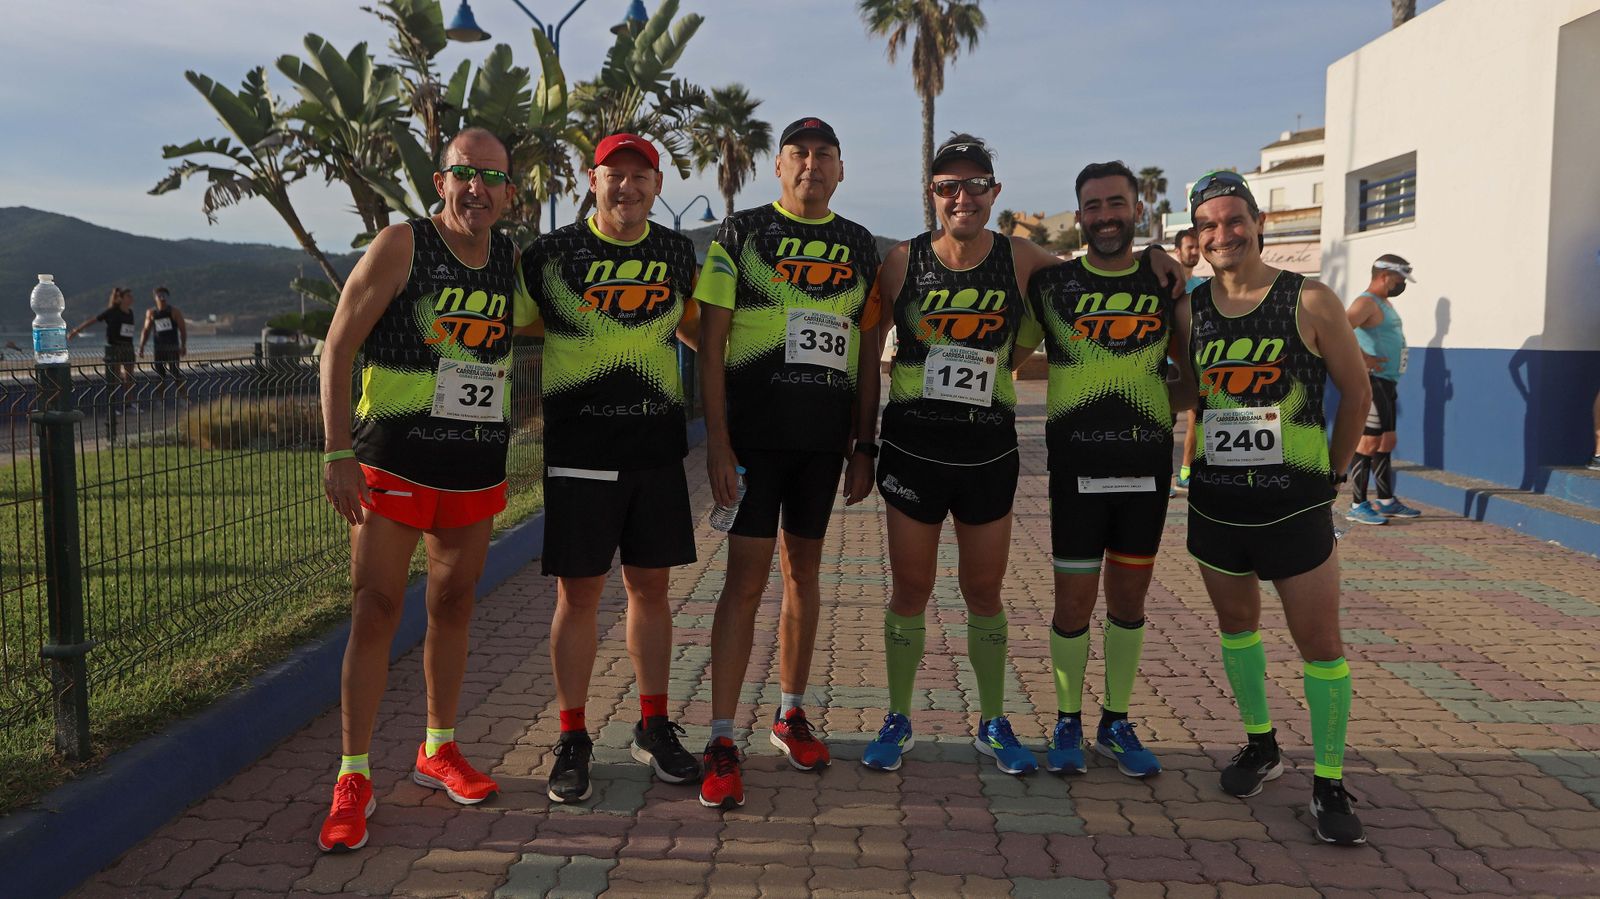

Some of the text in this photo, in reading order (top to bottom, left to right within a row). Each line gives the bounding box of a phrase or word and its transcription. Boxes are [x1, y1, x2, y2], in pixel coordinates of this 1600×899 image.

[776, 237, 850, 263] non
[584, 260, 668, 283] non
[770, 260, 853, 285] STOP
[433, 287, 506, 317] non
[577, 285, 670, 313] STOP
[920, 288, 1006, 311] non
[1074, 292, 1159, 313] non
[423, 317, 506, 348] STOP
[915, 314, 1004, 340] STOP
[1070, 316, 1161, 340] STOP
[799, 329, 846, 356] 338
[1200, 338, 1284, 365] non
[965, 354, 984, 362] URBANA
[938, 365, 988, 392] 121
[459, 383, 494, 407] 32
[406, 424, 506, 444] ALGECIRAS
[1070, 425, 1164, 443] ALGECIRAS
[1215, 429, 1275, 452] 240
